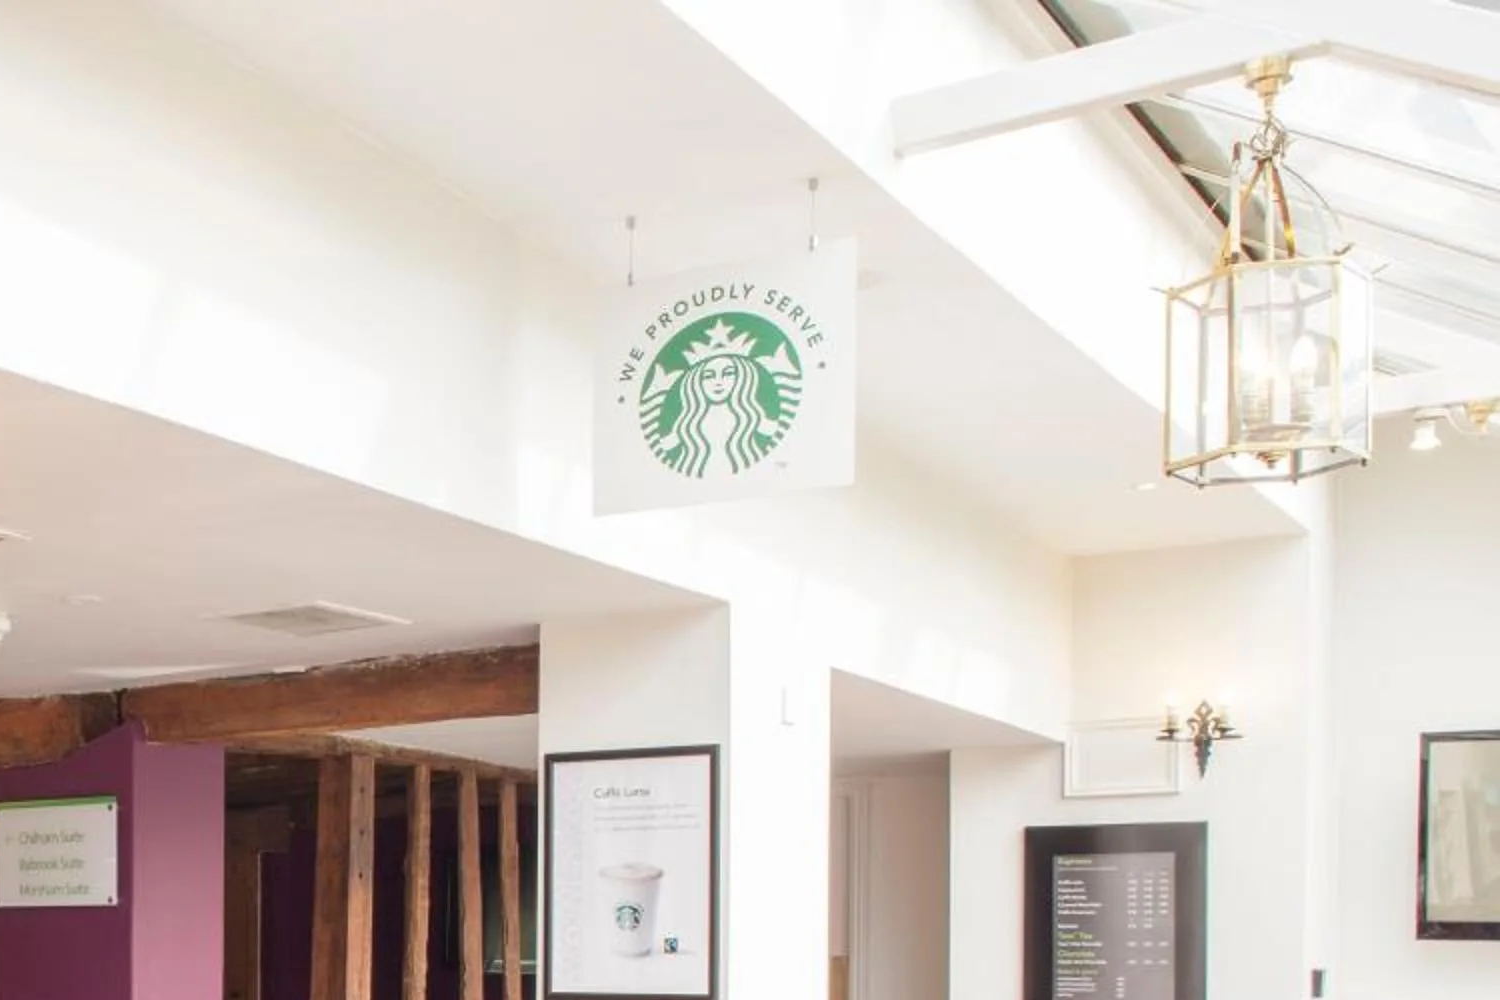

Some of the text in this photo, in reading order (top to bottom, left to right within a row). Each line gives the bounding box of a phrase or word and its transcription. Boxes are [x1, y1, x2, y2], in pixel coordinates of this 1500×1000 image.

[619, 283, 824, 382] WE PROUDLY SERVE
[624, 786, 651, 798] Latte
[60, 829, 85, 843] Suite
[60, 856, 85, 869] Suite
[65, 882, 90, 896] Suite
